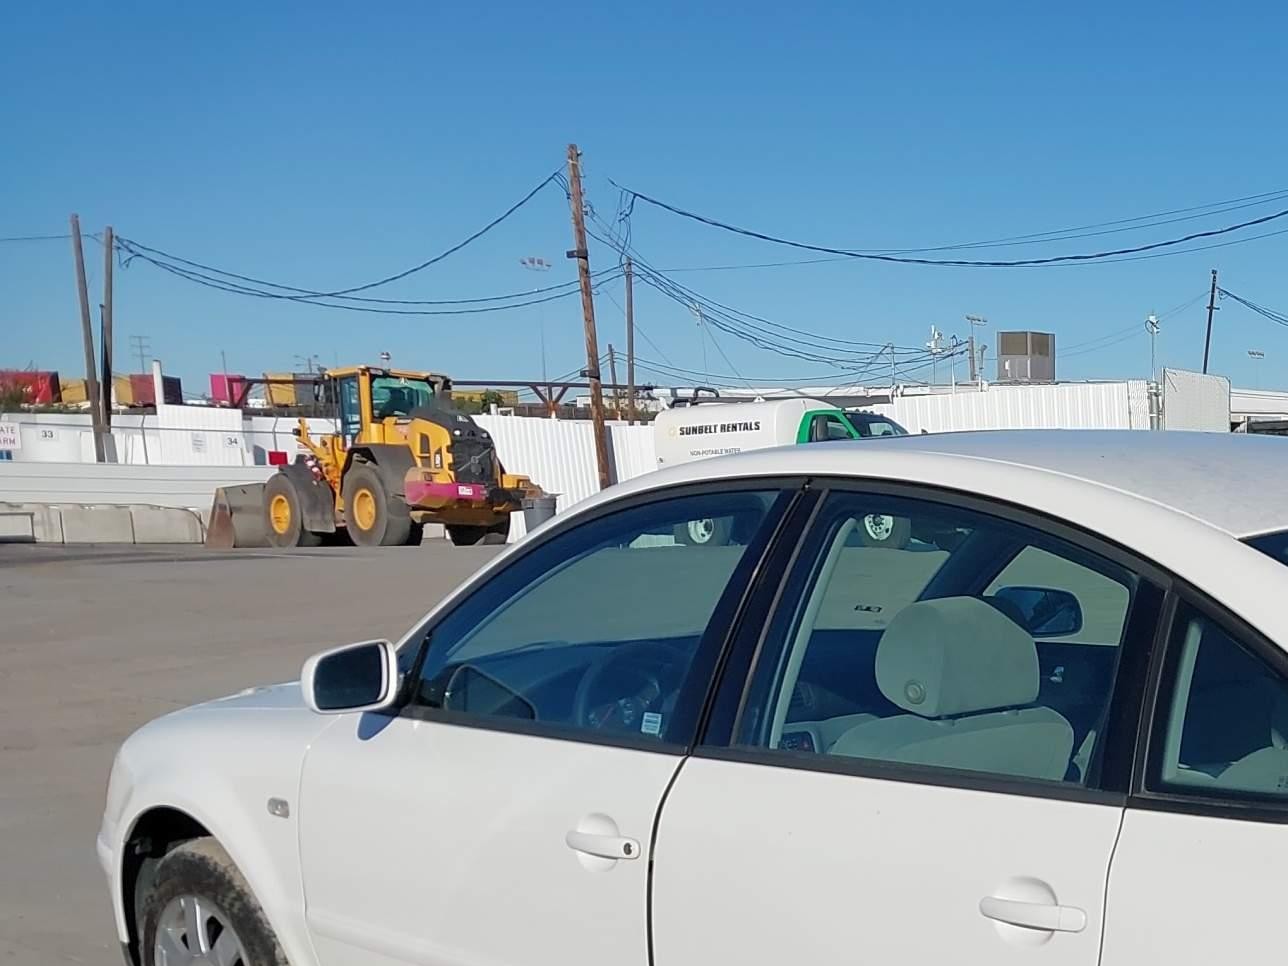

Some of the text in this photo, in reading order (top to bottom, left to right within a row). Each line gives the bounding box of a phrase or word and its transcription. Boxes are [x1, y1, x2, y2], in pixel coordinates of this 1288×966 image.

[679, 421, 761, 436] SUNBELT RENTALS
[226, 436, 238, 446] 34
